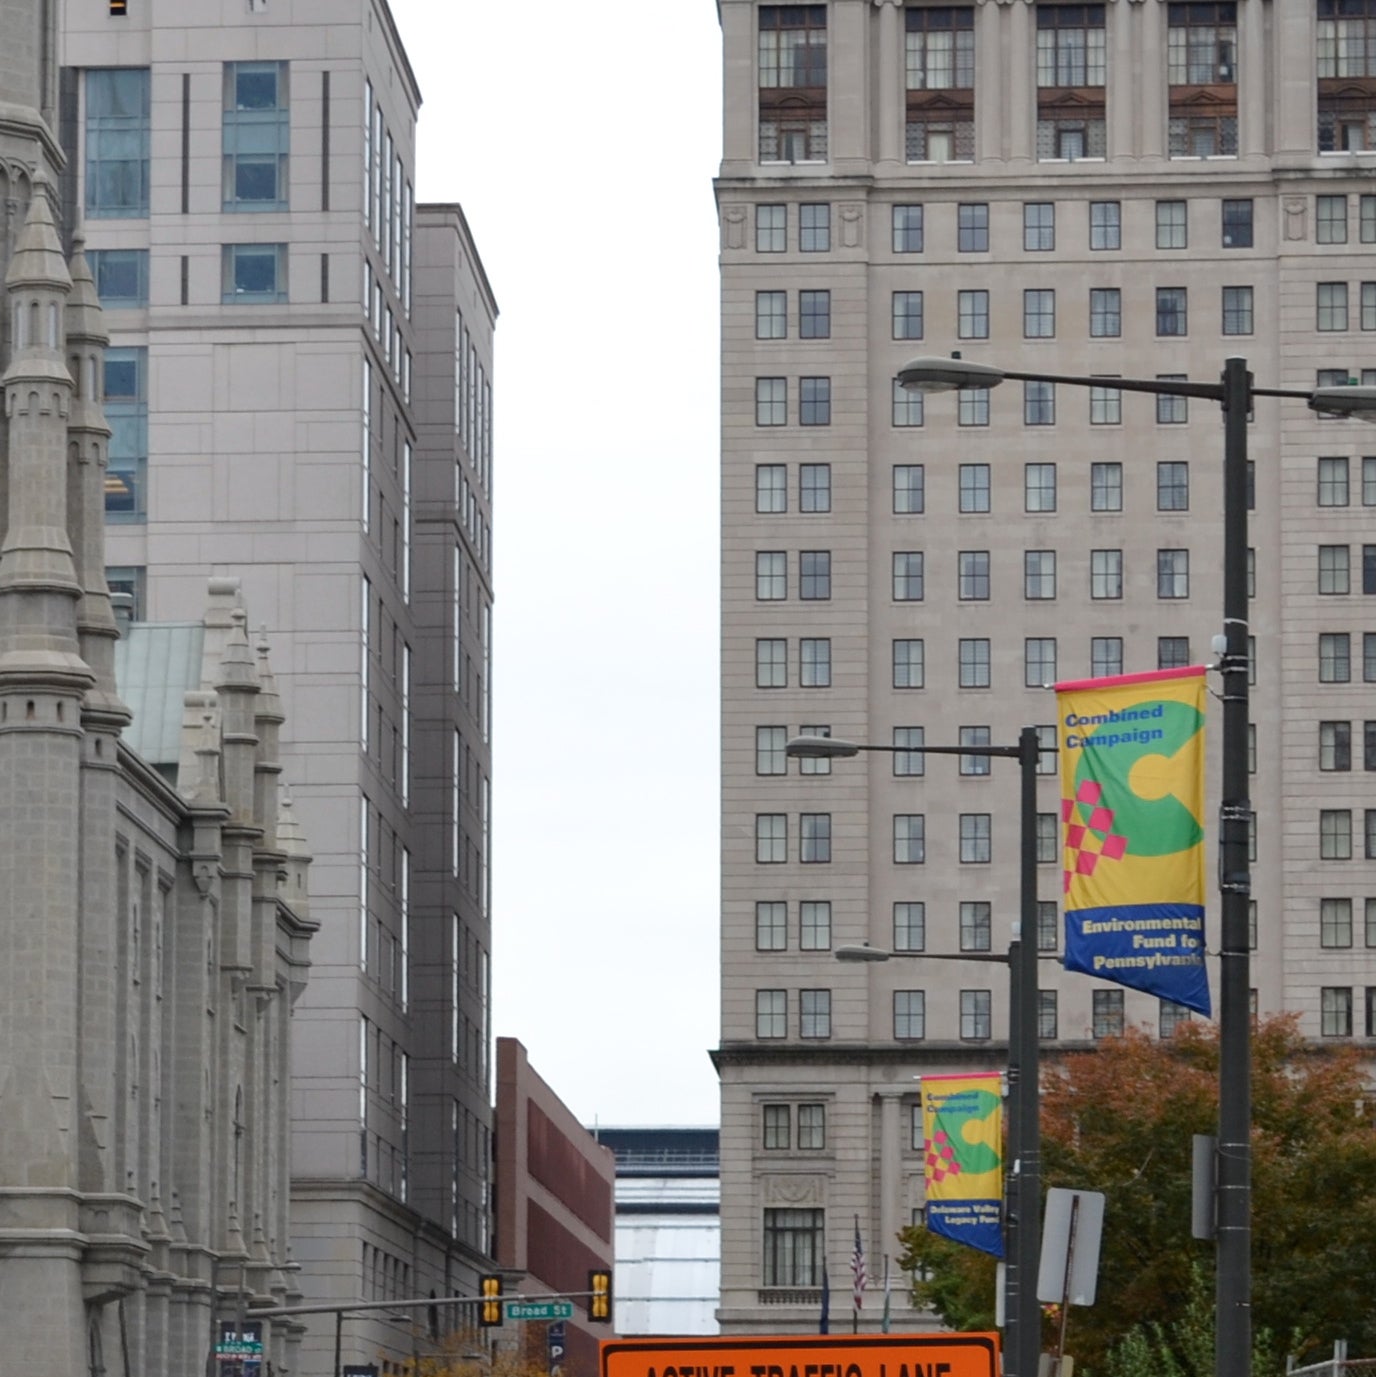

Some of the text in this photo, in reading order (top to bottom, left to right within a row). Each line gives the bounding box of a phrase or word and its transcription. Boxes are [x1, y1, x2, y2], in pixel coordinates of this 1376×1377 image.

[1065, 705, 1164, 728] Combined
[1066, 728, 1164, 748] Campaign
[1082, 918, 1202, 935] Environmental
[1133, 934, 1177, 949] Fund
[512, 1305, 567, 1316] Broad St
